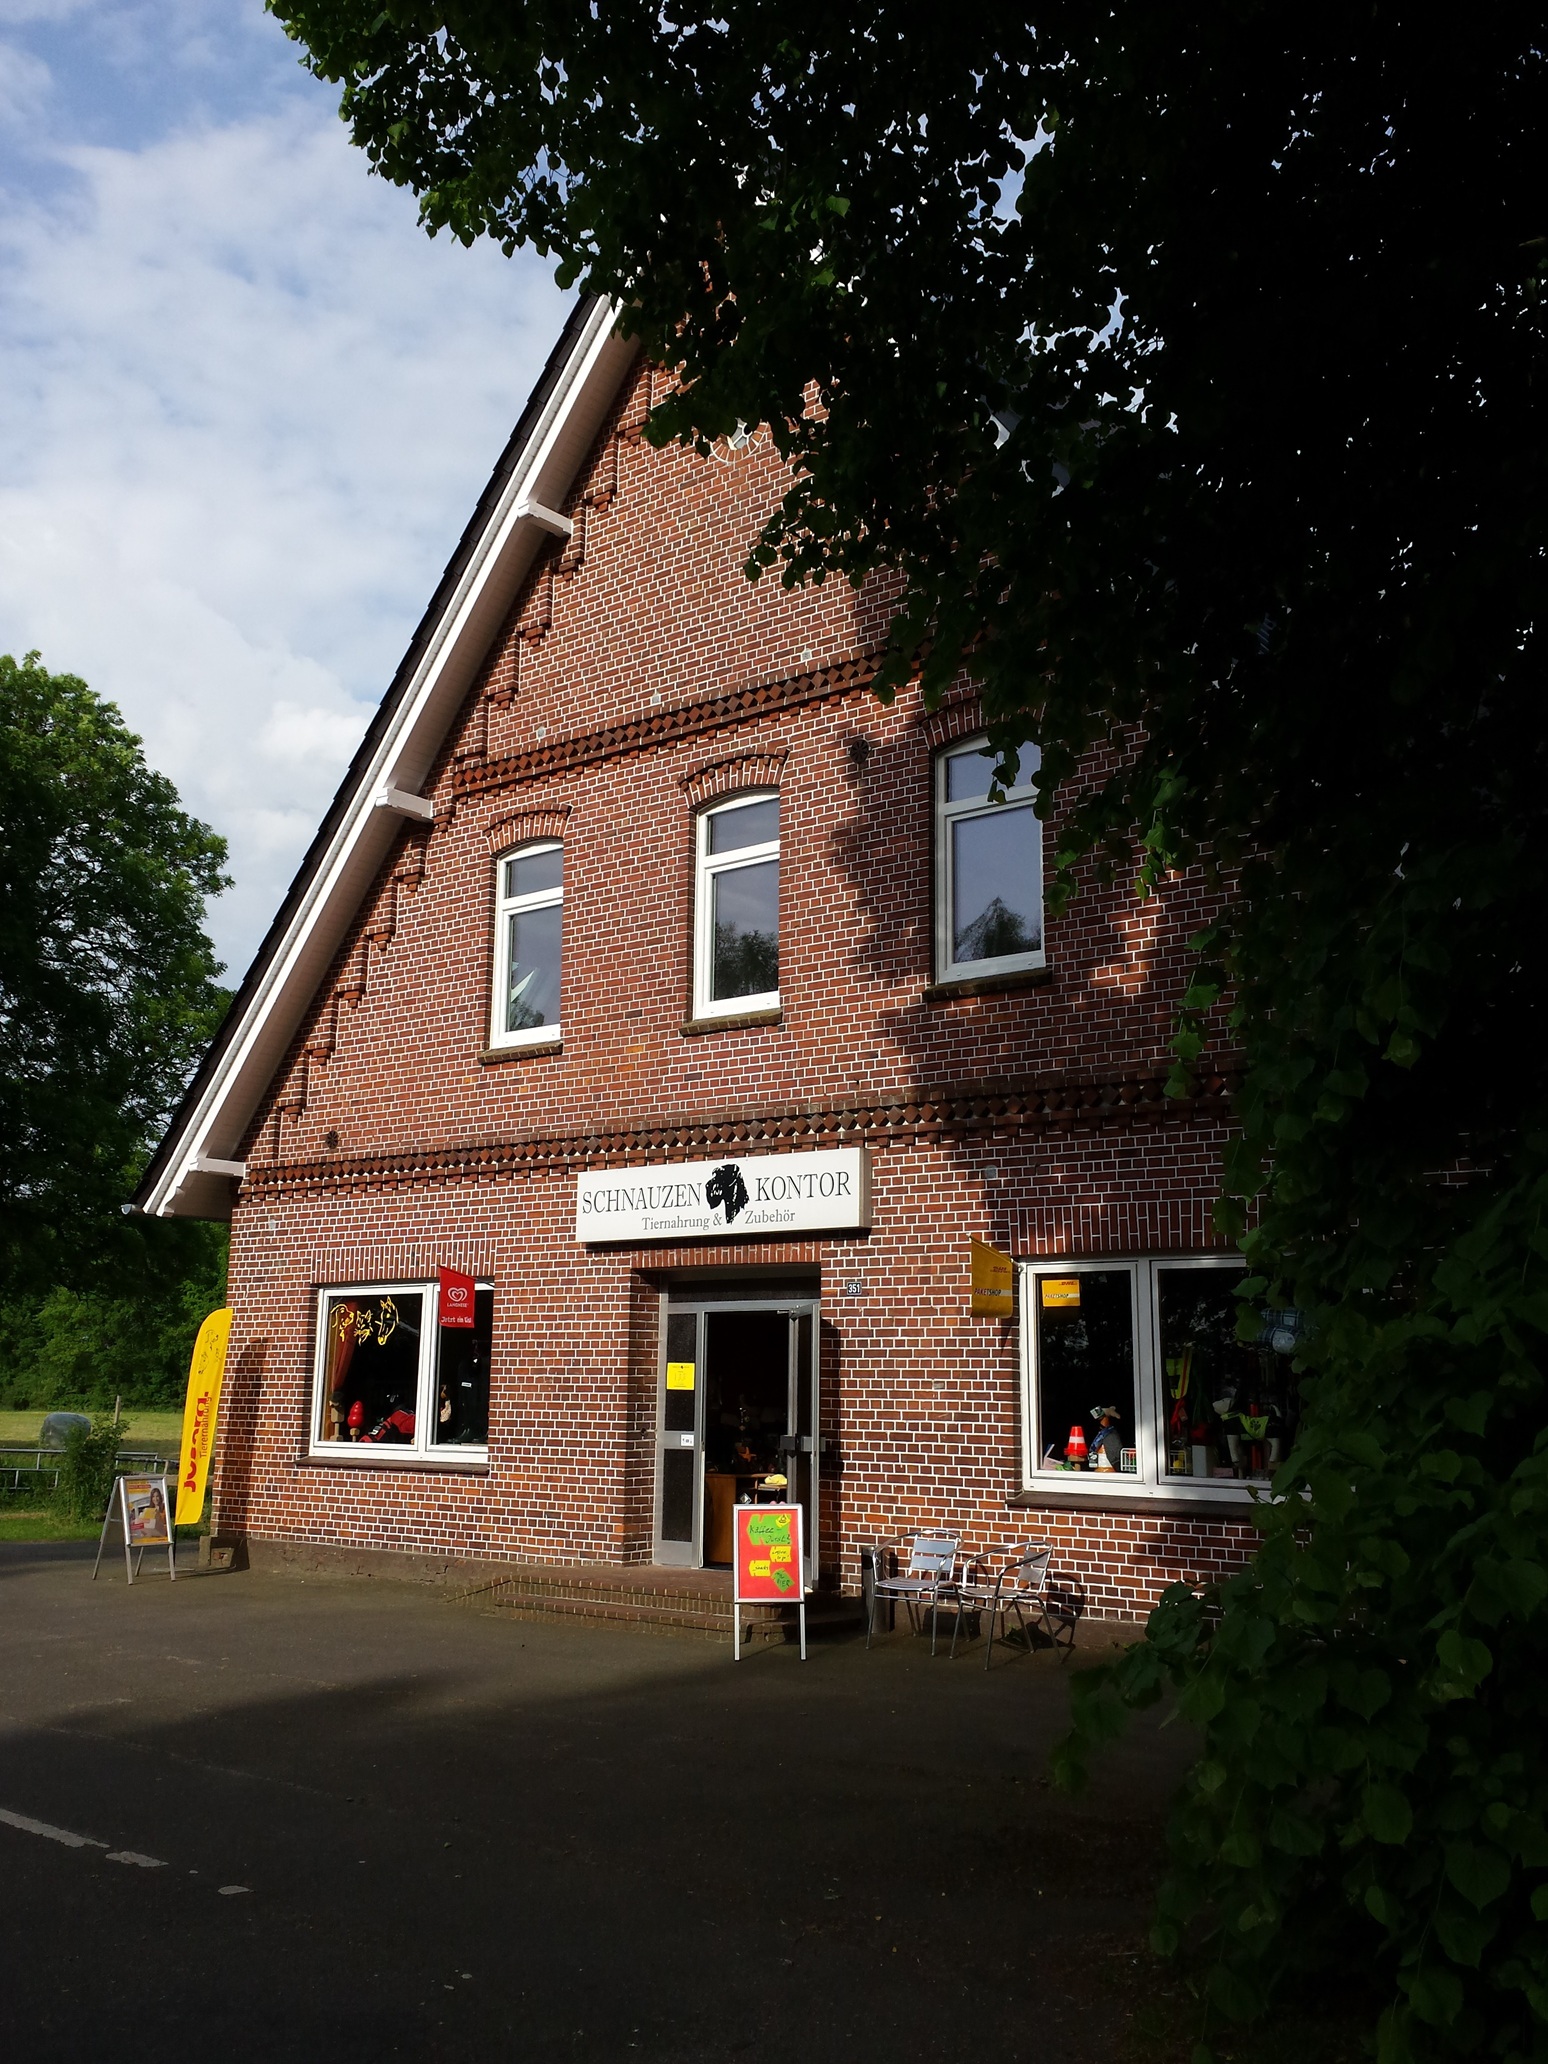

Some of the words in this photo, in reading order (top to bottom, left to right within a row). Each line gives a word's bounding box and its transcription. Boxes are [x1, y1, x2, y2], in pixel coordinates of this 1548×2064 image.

[581, 1182, 702, 1214] SCHNAUZEN
[754, 1170, 851, 1202] KONTOR
[641, 1216, 711, 1231] Tiernahrung
[712, 1213, 723, 1227] &
[744, 1208, 796, 1225] Zubehör
[848, 1283, 860, 1293] 351
[974, 1287, 1002, 1297] PAKETSHOP
